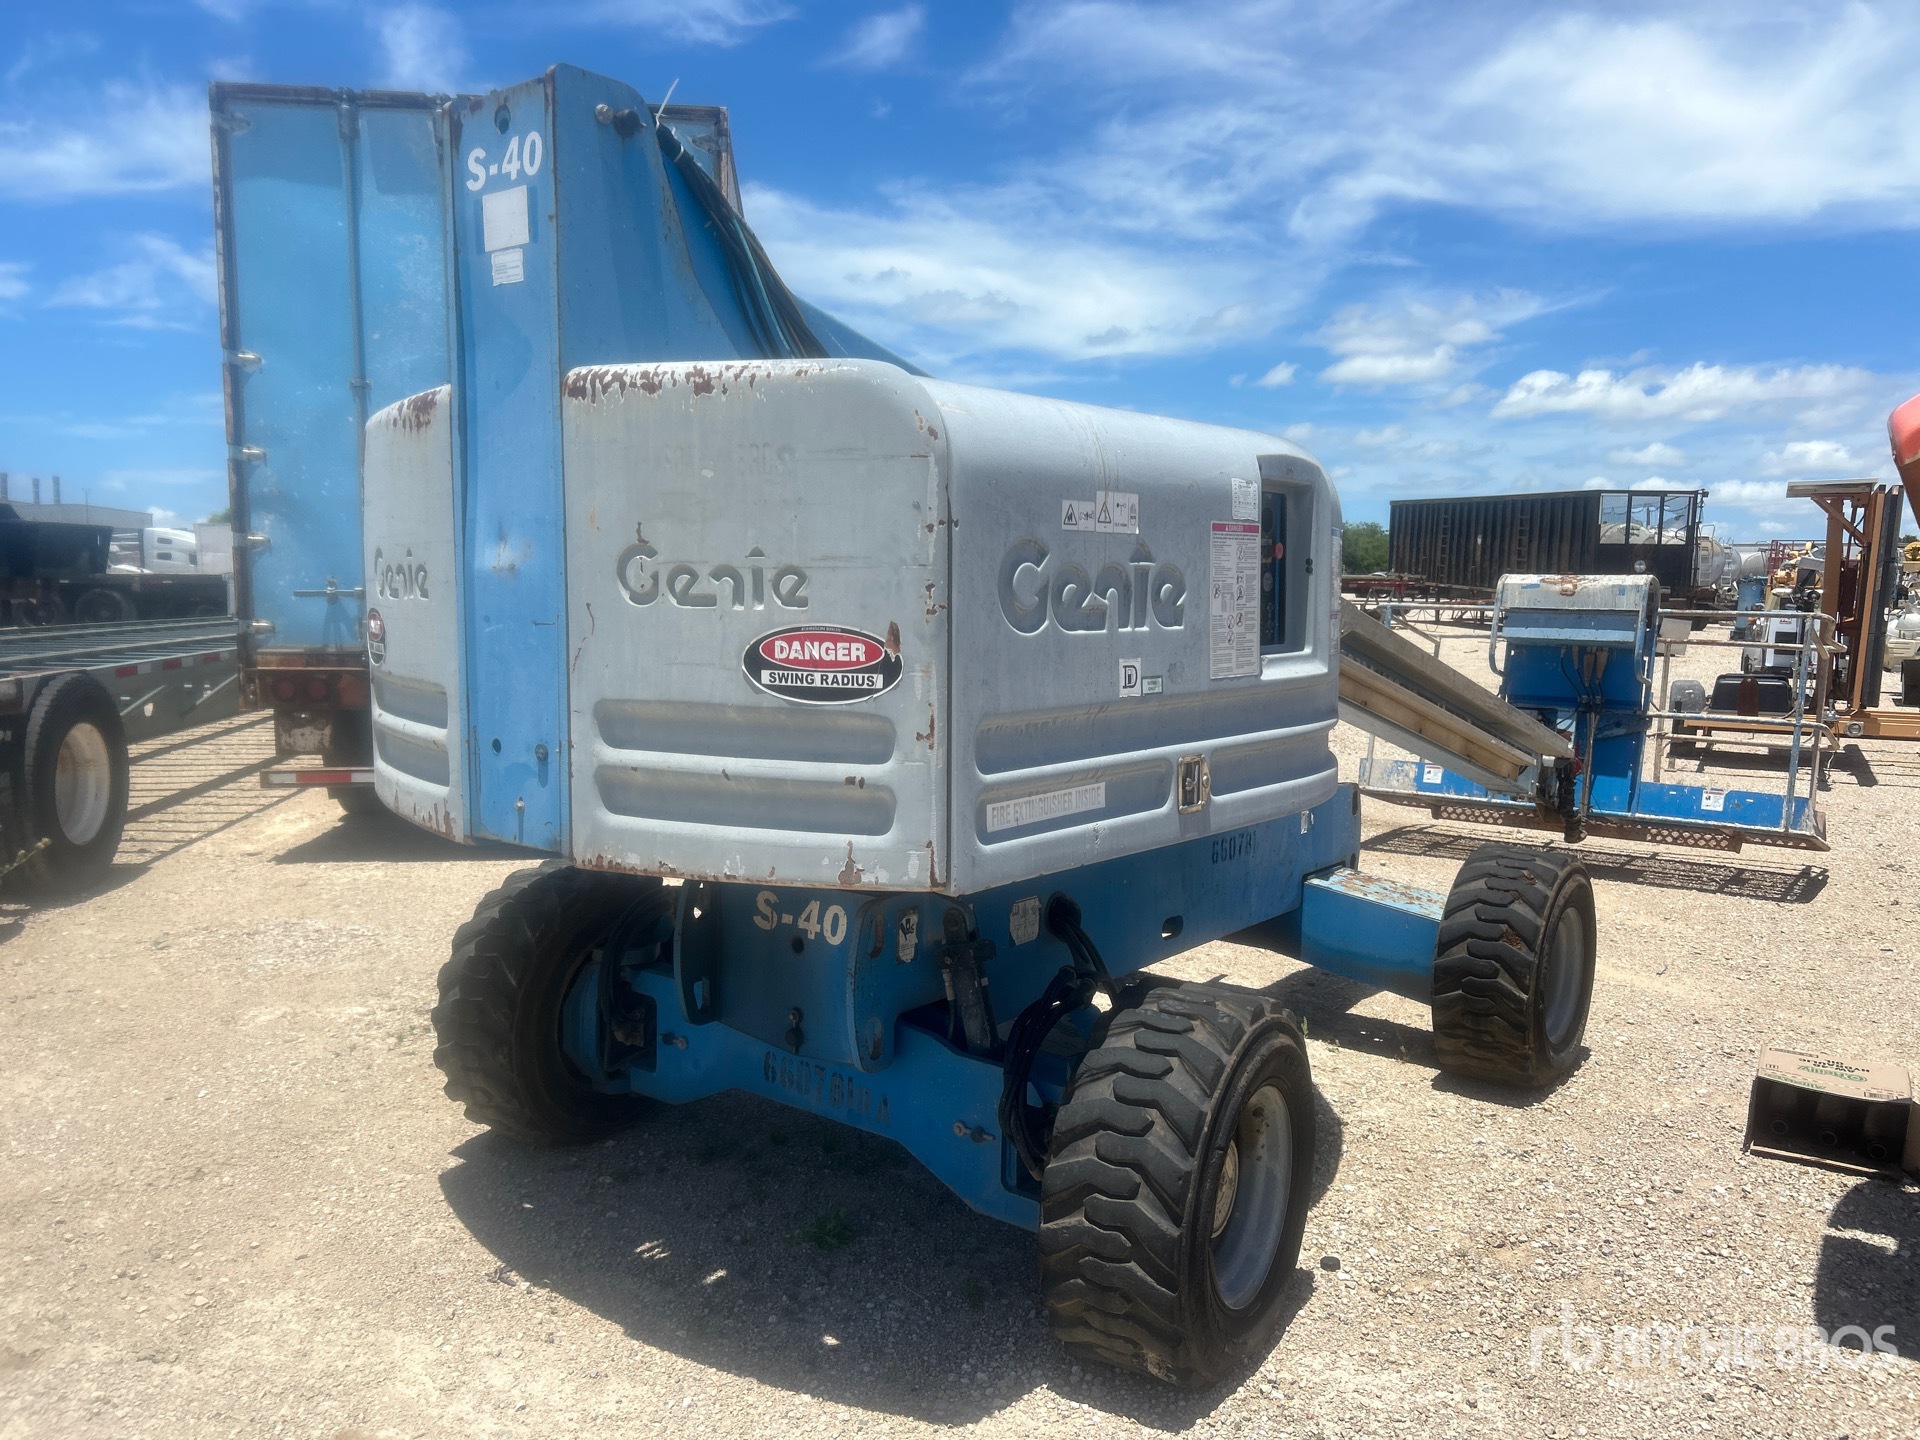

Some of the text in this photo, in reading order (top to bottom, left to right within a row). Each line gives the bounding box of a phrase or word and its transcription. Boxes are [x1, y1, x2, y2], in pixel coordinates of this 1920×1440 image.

[466, 131, 543, 192] S-40
[374, 547, 429, 600] Genie
[616, 543, 809, 610] Genie
[998, 535, 1187, 636] Genie
[774, 640, 866, 662] DANGER
[769, 671, 875, 688] SWING RADIUS
[991, 786, 1101, 828] FIRE EXTINGUISHER INSIDE
[753, 890, 847, 945] S-40
